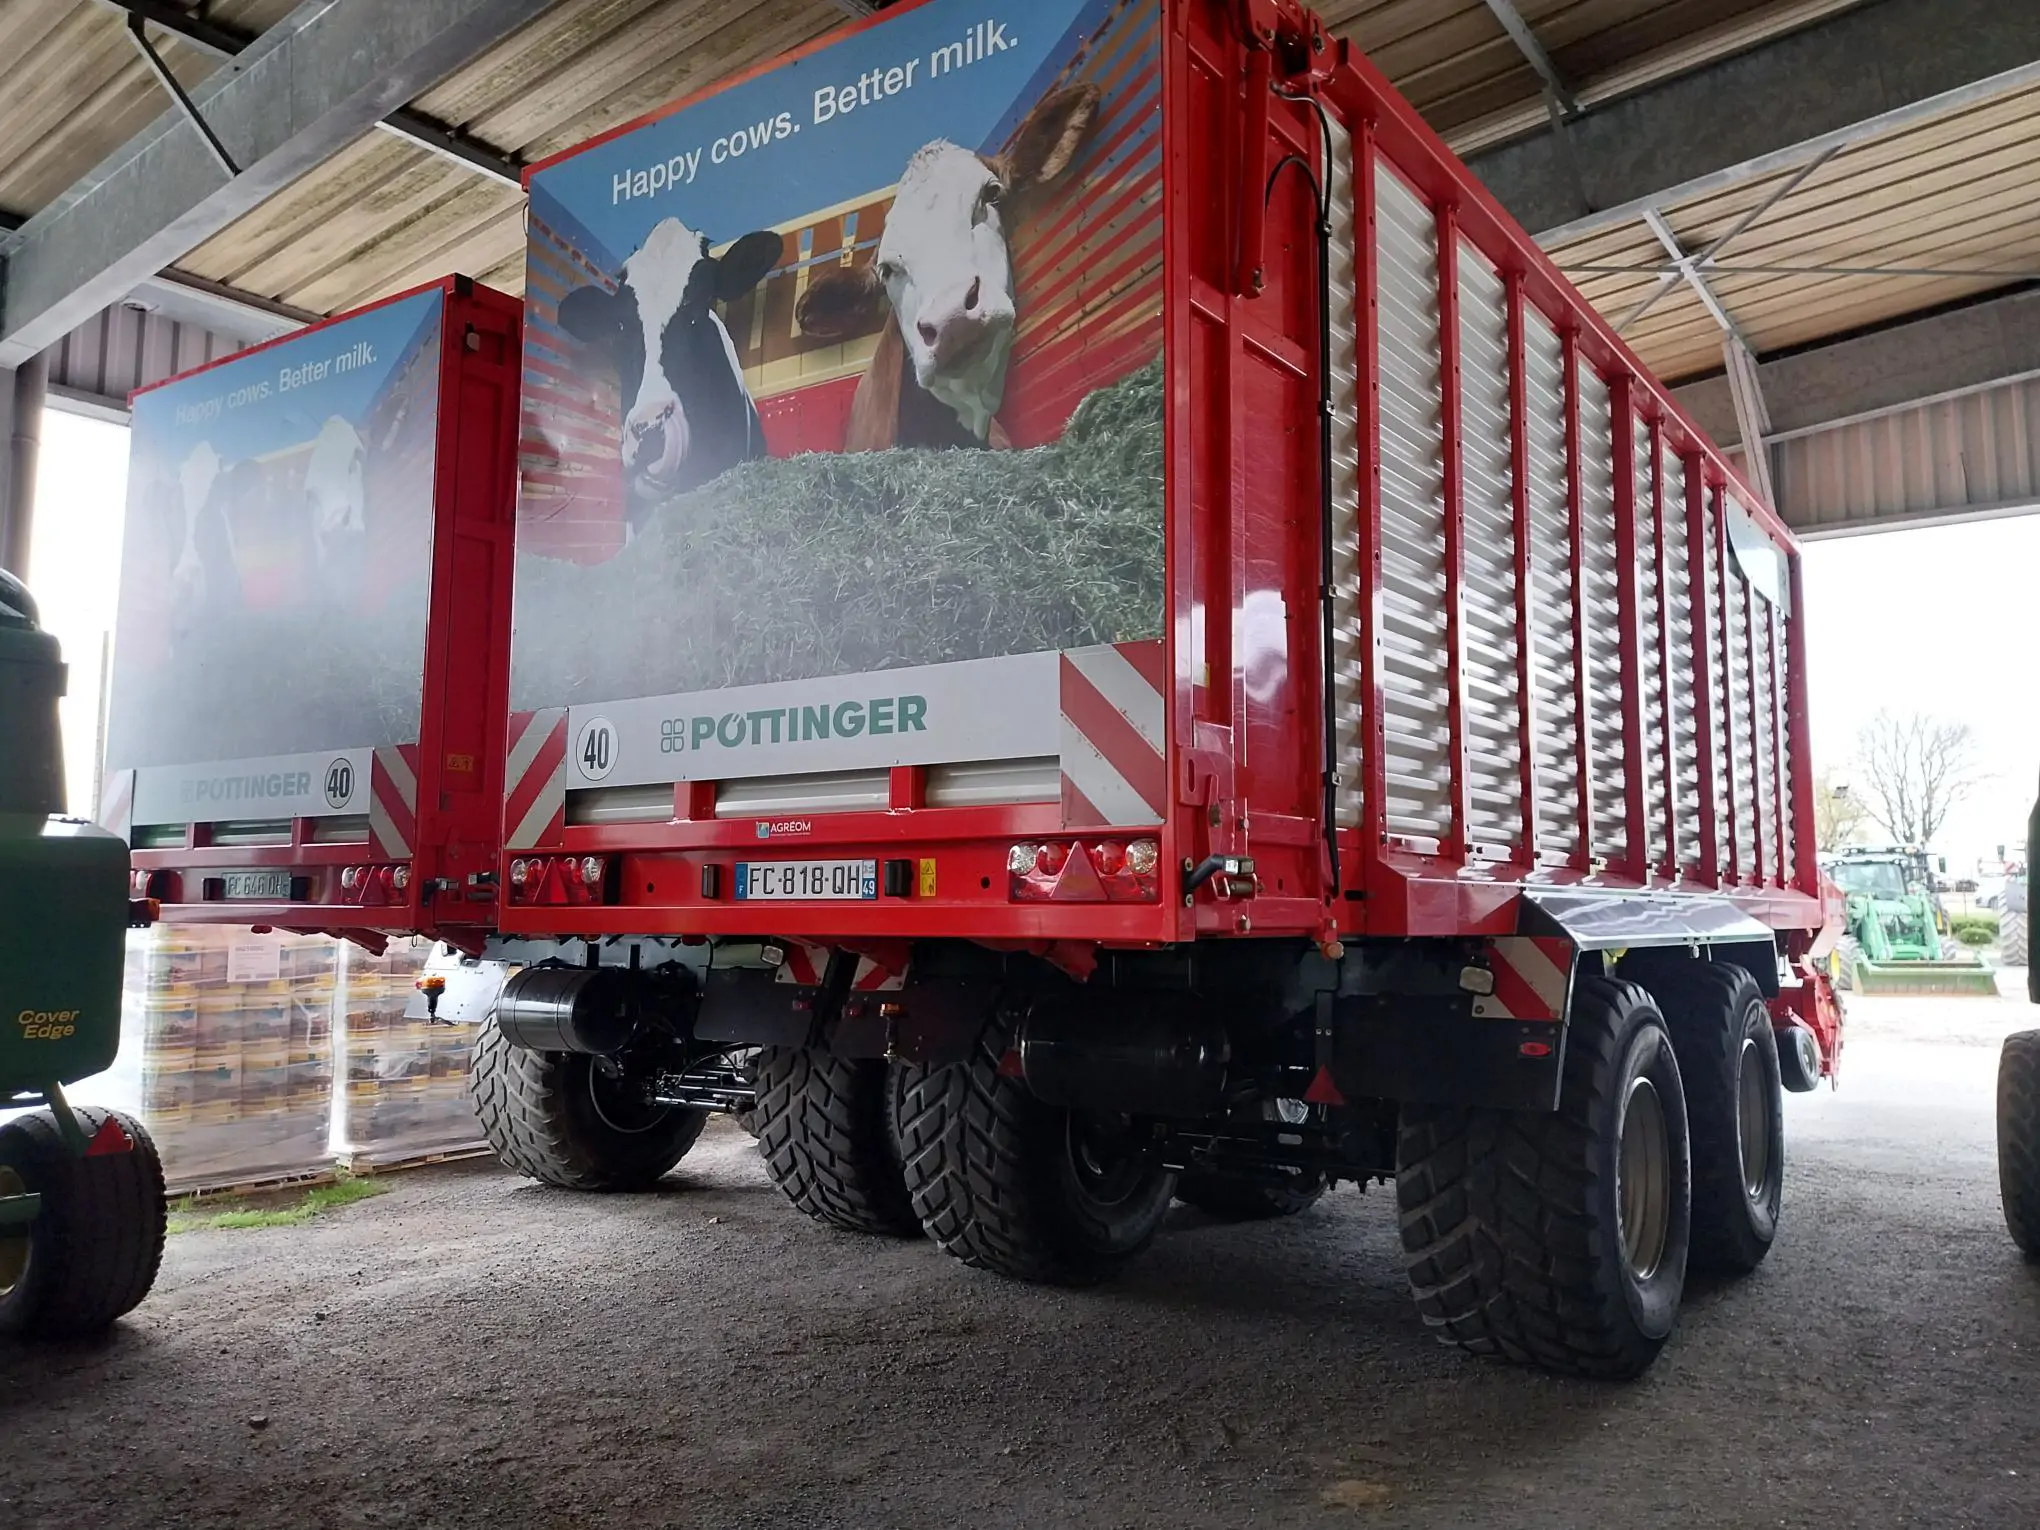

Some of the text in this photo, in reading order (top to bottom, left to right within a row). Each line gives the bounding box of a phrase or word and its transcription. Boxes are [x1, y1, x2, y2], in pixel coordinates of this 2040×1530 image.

[612, 19, 1019, 205] Happy cows. Better milk.
[175, 341, 378, 427] Happy cows. Better milk.
[583, 727, 610, 770] 40
[327, 766, 351, 799] 40
[862, 880, 875, 895] 49
[18, 1009, 80, 1025] Cover
[23, 1023, 75, 1040] Edge
